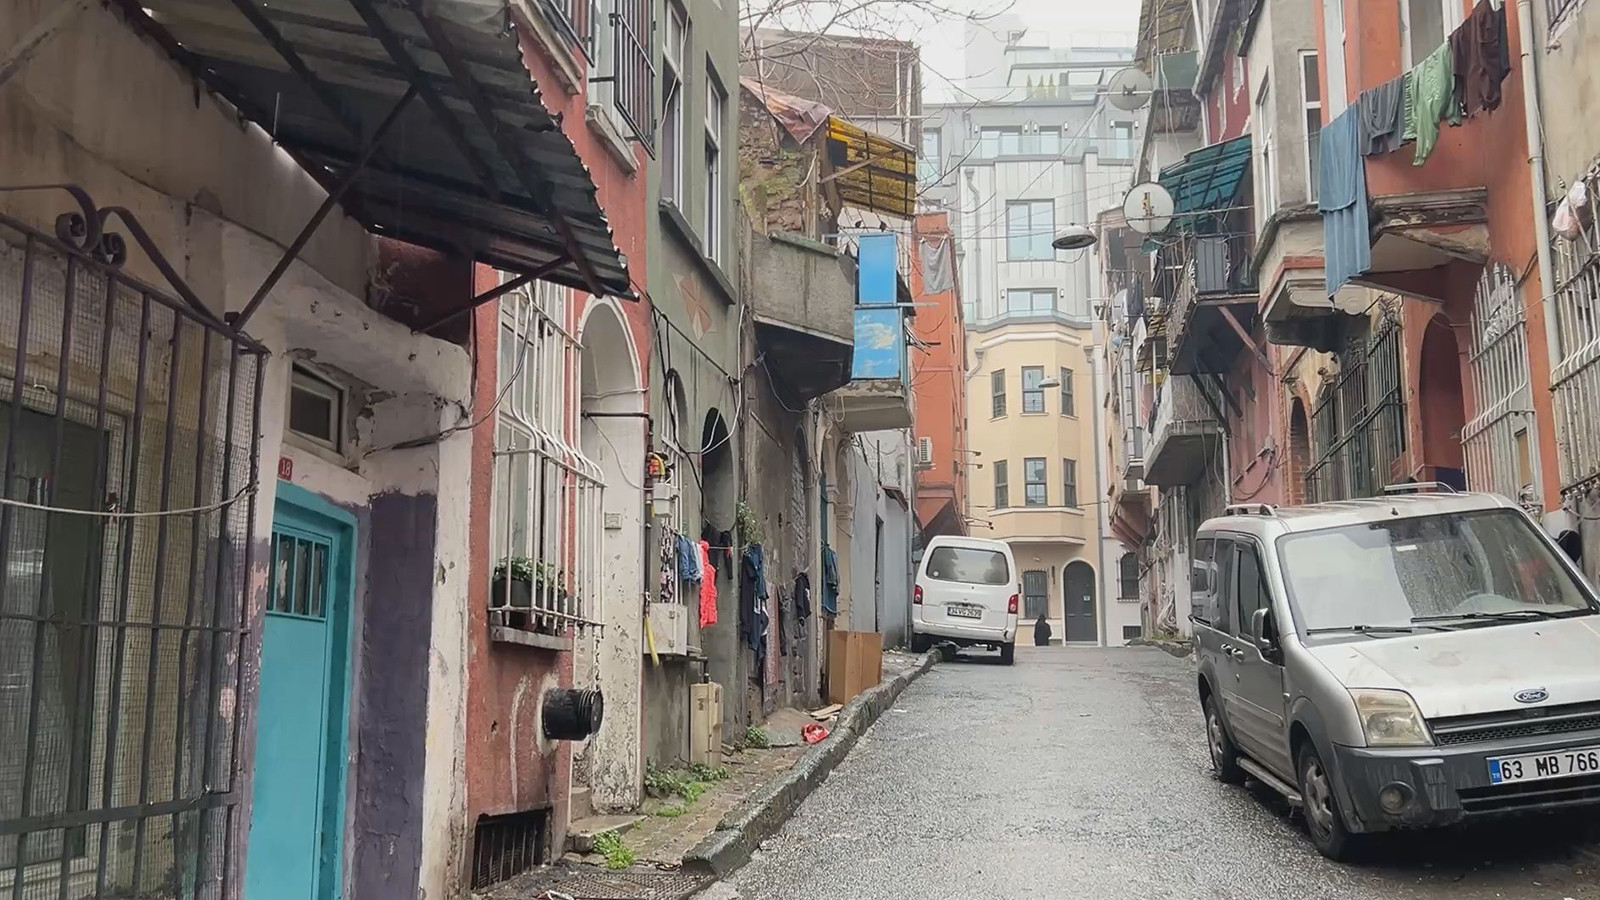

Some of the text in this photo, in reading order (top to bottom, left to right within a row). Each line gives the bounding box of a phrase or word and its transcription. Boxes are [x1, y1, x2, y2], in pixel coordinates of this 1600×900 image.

[281, 459, 291, 476] 18
[1502, 752, 1598, 779] 63 MB 766
